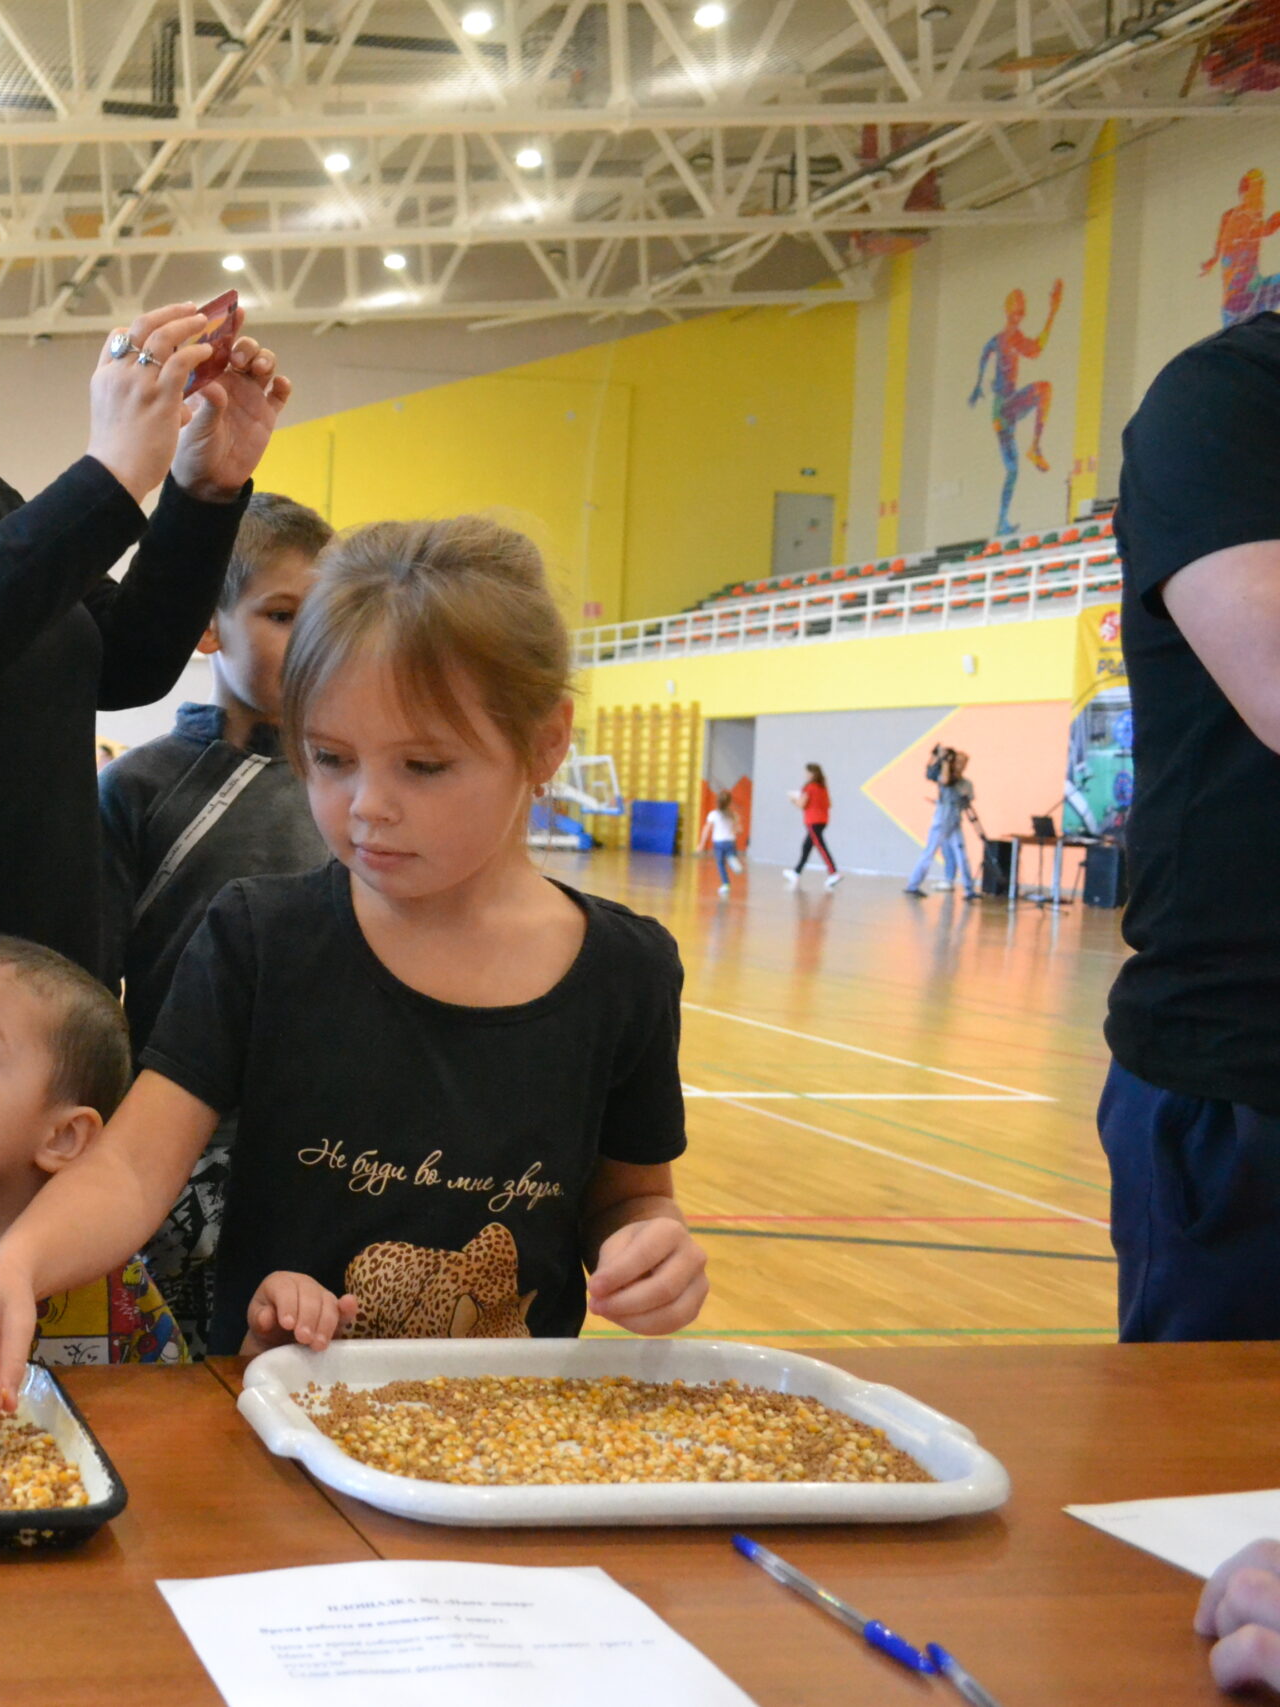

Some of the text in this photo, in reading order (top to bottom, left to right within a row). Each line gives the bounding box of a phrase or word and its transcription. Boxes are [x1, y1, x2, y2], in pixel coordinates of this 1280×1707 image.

[298, 1138, 348, 1169] Не
[348, 1150, 407, 1196] буди
[413, 1150, 442, 1185] во
[447, 1175, 495, 1192] мне
